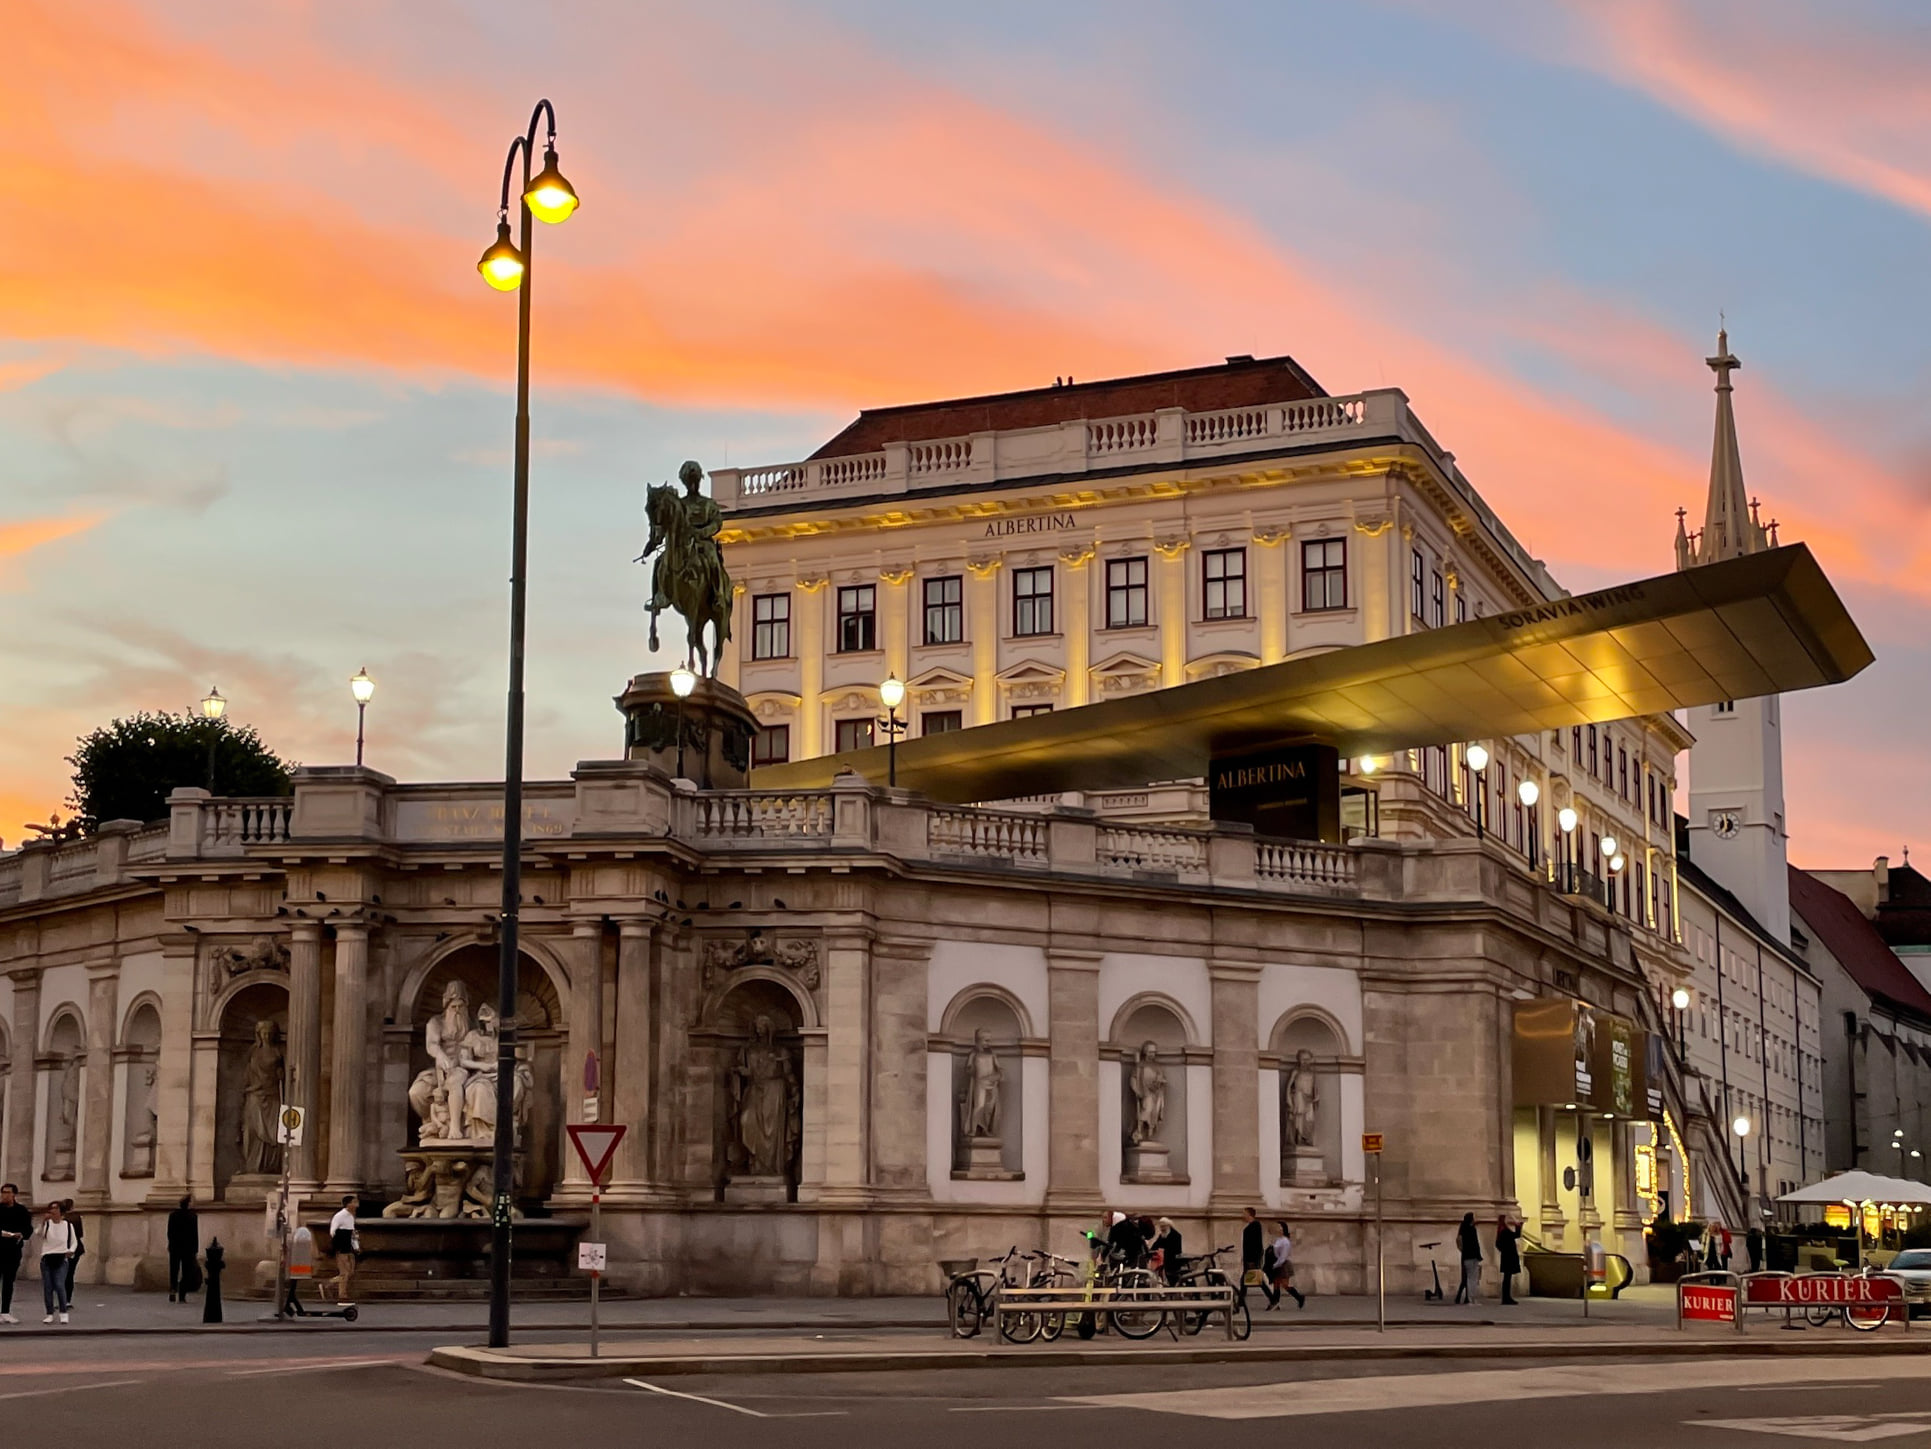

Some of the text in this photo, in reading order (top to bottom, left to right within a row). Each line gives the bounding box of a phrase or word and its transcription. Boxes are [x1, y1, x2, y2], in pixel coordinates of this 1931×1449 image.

[985, 514, 1076, 537] ALBERTINA
[1498, 584, 1646, 630] SORAVIA WING
[1217, 761, 1306, 790] ALBERTINA
[1780, 1279, 1874, 1301] KURIER
[1683, 1295, 1734, 1312] KURIER
